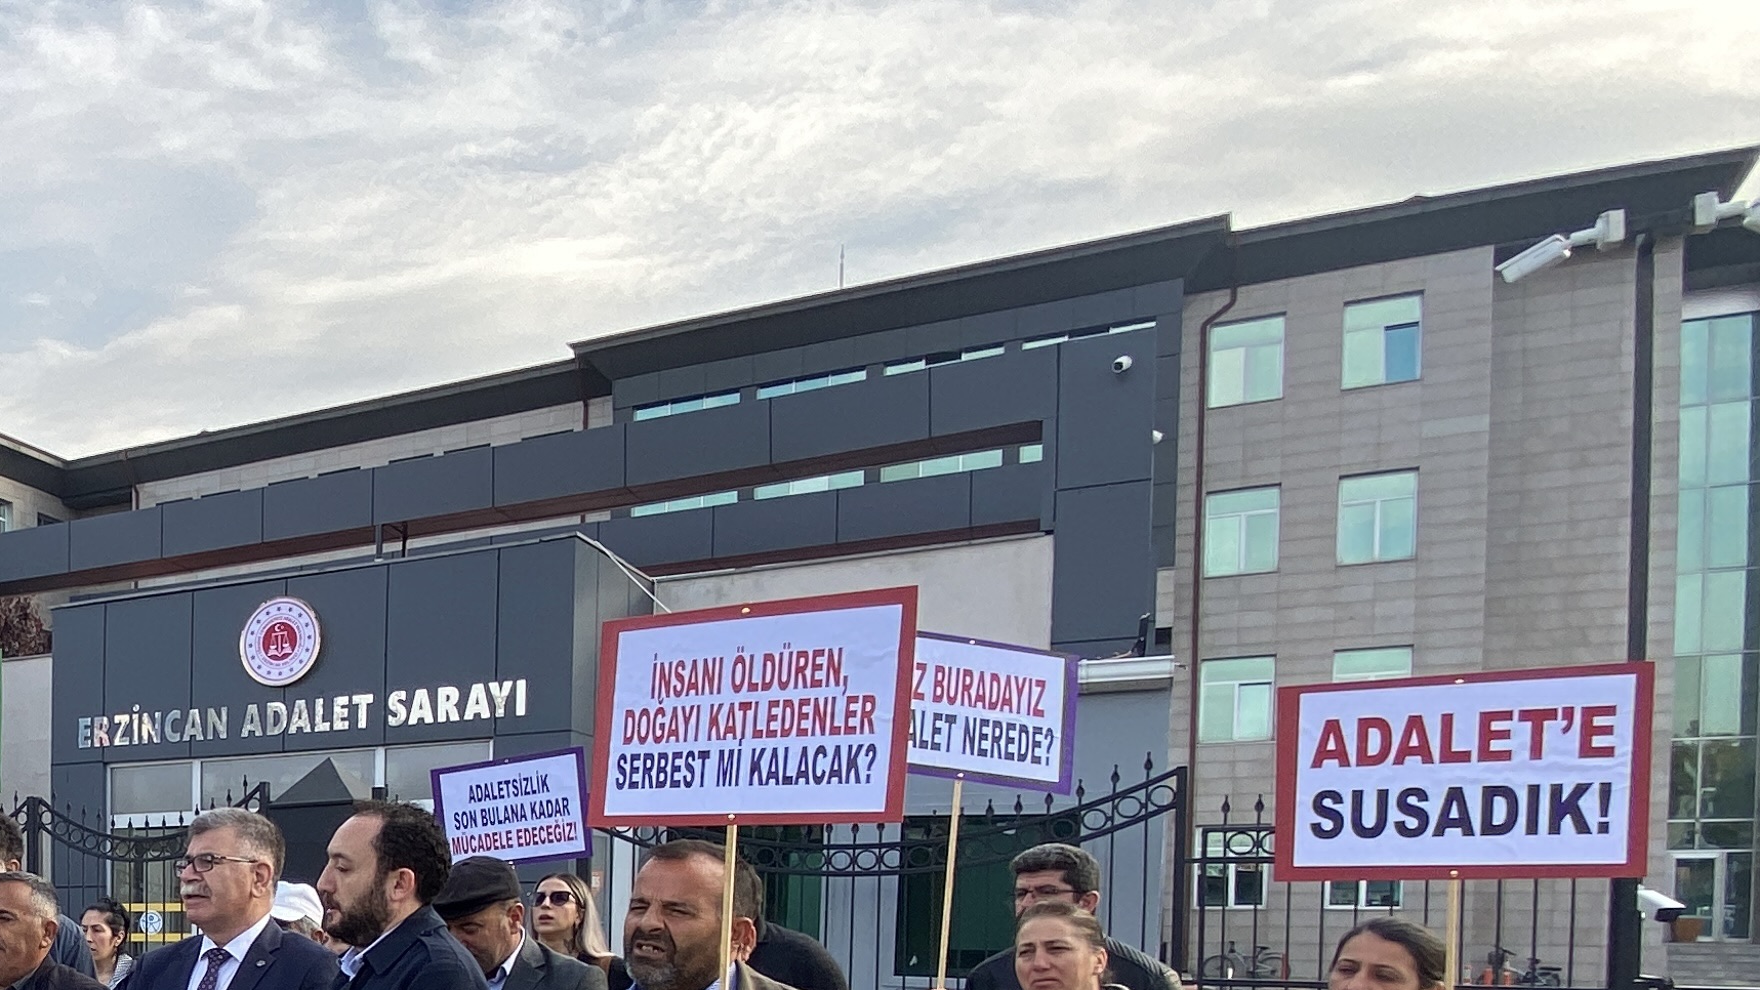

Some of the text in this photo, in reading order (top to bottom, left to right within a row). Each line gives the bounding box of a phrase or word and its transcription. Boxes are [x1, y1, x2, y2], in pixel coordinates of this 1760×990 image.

[651, 642, 849, 699] İNSANI ÖLDÜREN,
[932, 664, 1047, 718] BURADAYIZ
[78, 679, 527, 749] ERZİNCAN ADALET SARAYI
[622, 694, 877, 745] DOĞAYI KATLEDENLER
[907, 708, 1055, 766] ALET NEREDE?
[468, 770, 550, 804] ADALETSİZLİK
[615, 738, 877, 790] SERBEST Mİ KALACAK?
[452, 818, 578, 855] MÜCADELE EDECEĞİZ!
[453, 797, 571, 831] SON BULANA KADAR
[1309, 782, 1613, 839] SUSADIK!
